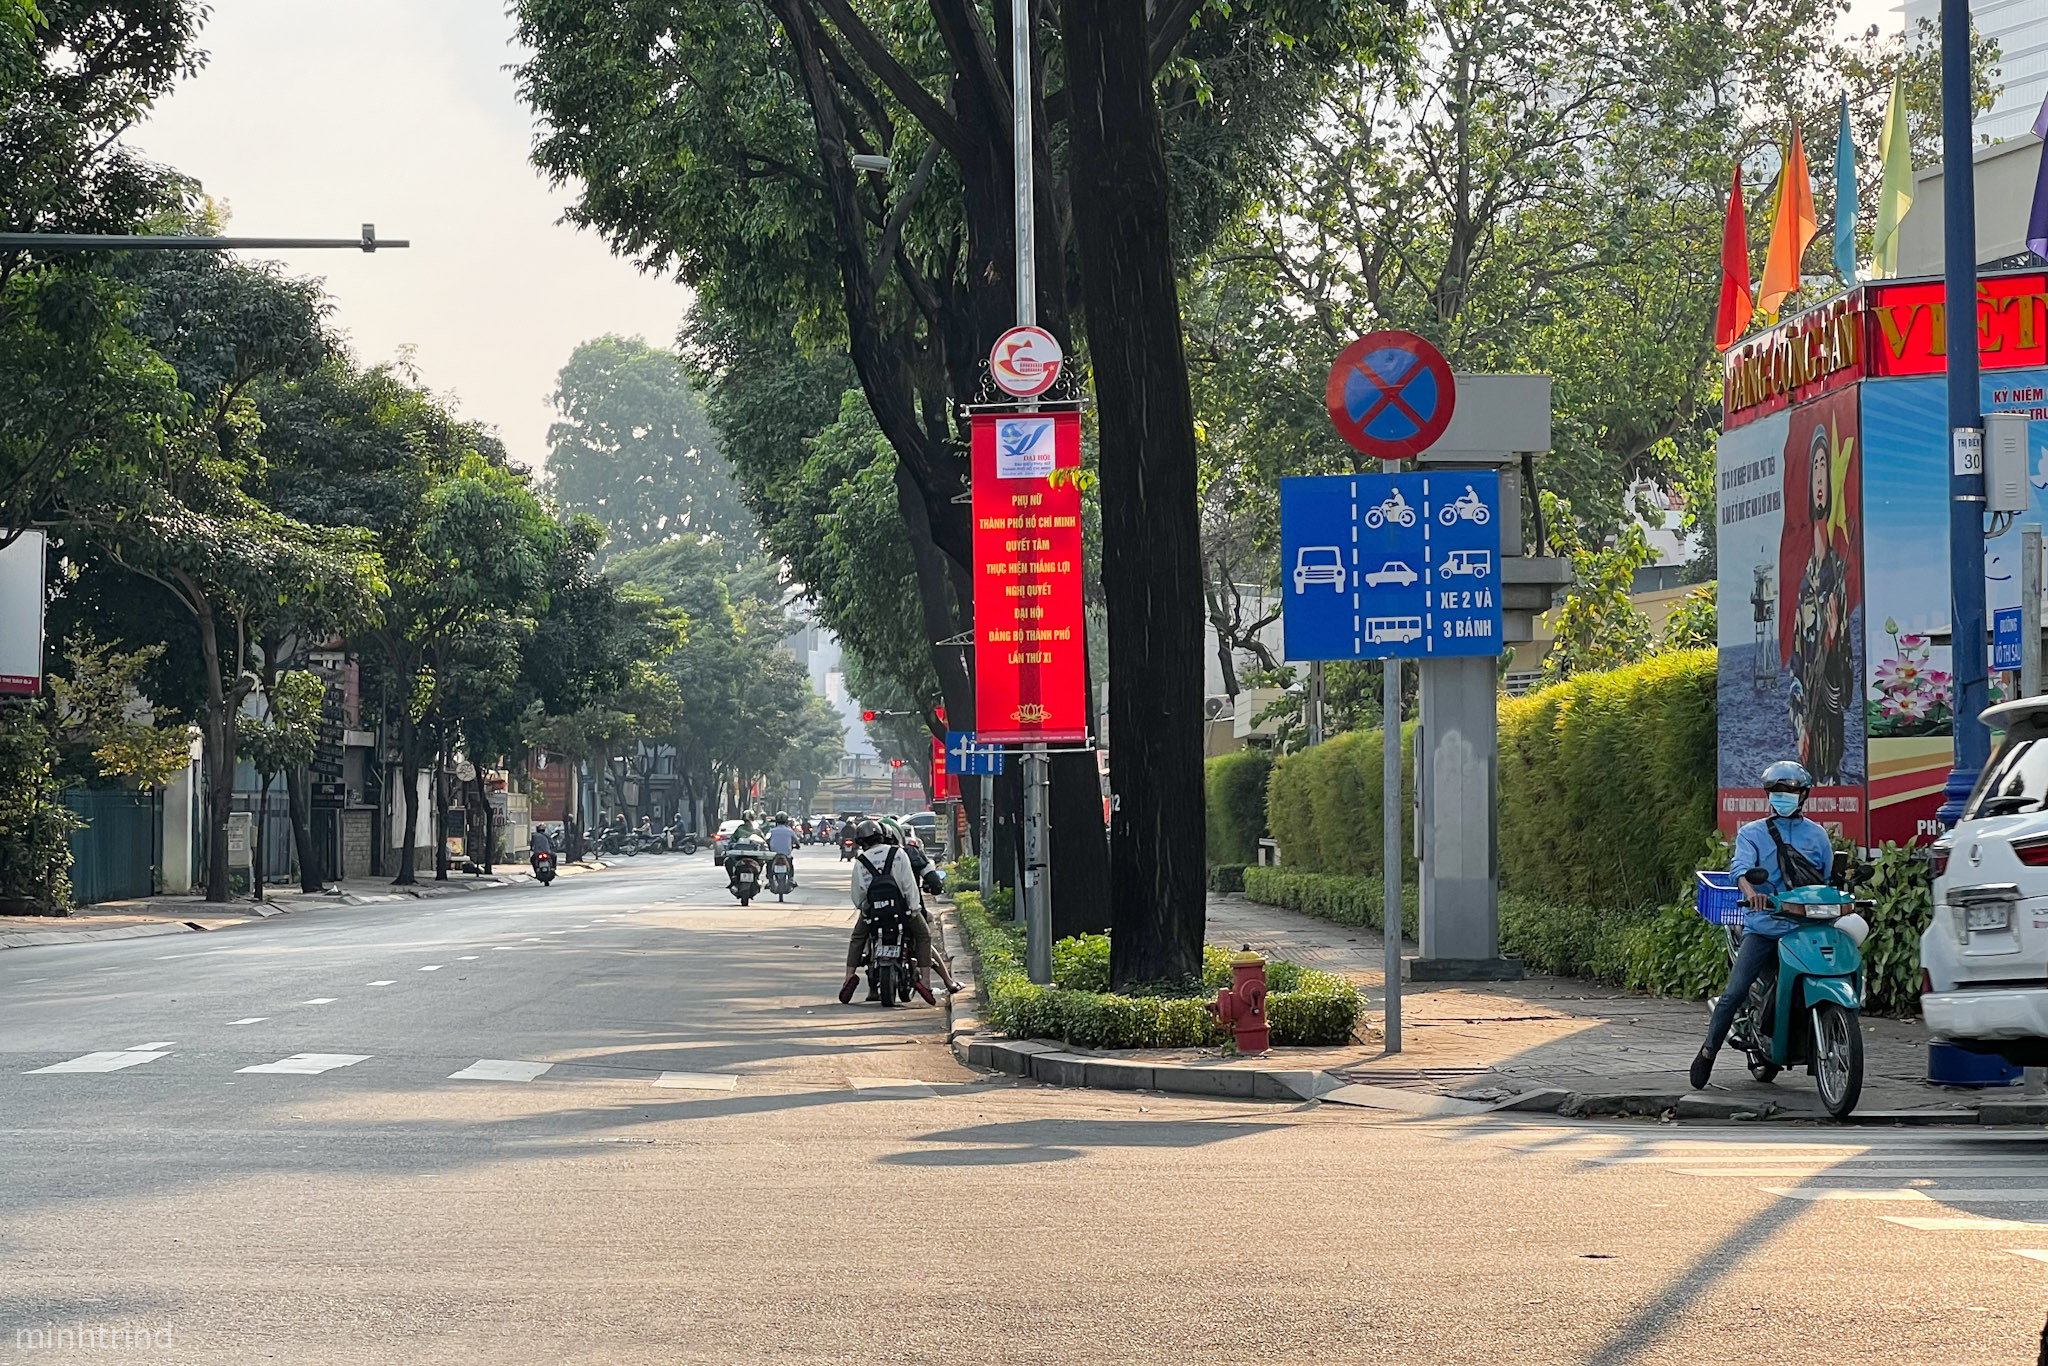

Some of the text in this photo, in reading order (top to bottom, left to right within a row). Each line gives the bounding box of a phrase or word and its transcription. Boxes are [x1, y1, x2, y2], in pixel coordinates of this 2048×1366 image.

[1994, 386, 2043, 404] KỶ NIỆM
[1964, 453, 1980, 469] 30
[1012, 493, 1042, 508] PHỤ NỮ
[979, 514, 1076, 529] THÀNH PHỐ HỒ CHÍ MINH
[1006, 537, 1050, 552] QUYẾT TÂM
[986, 558, 1070, 576] THỰC HIỆN THẮNG LỢI
[1005, 582, 1051, 598] NGHỊ QUYẾT
[1440, 587, 1493, 609] XE 2 VÀ
[1014, 605, 1044, 621] ĐẠI HỘI
[989, 626, 1070, 643] ĐẢNG BỘ THÀNH PHỐ
[1443, 617, 1492, 638] 3 BÁNH
[1008, 650, 1051, 664] LẦN THỨ XI
